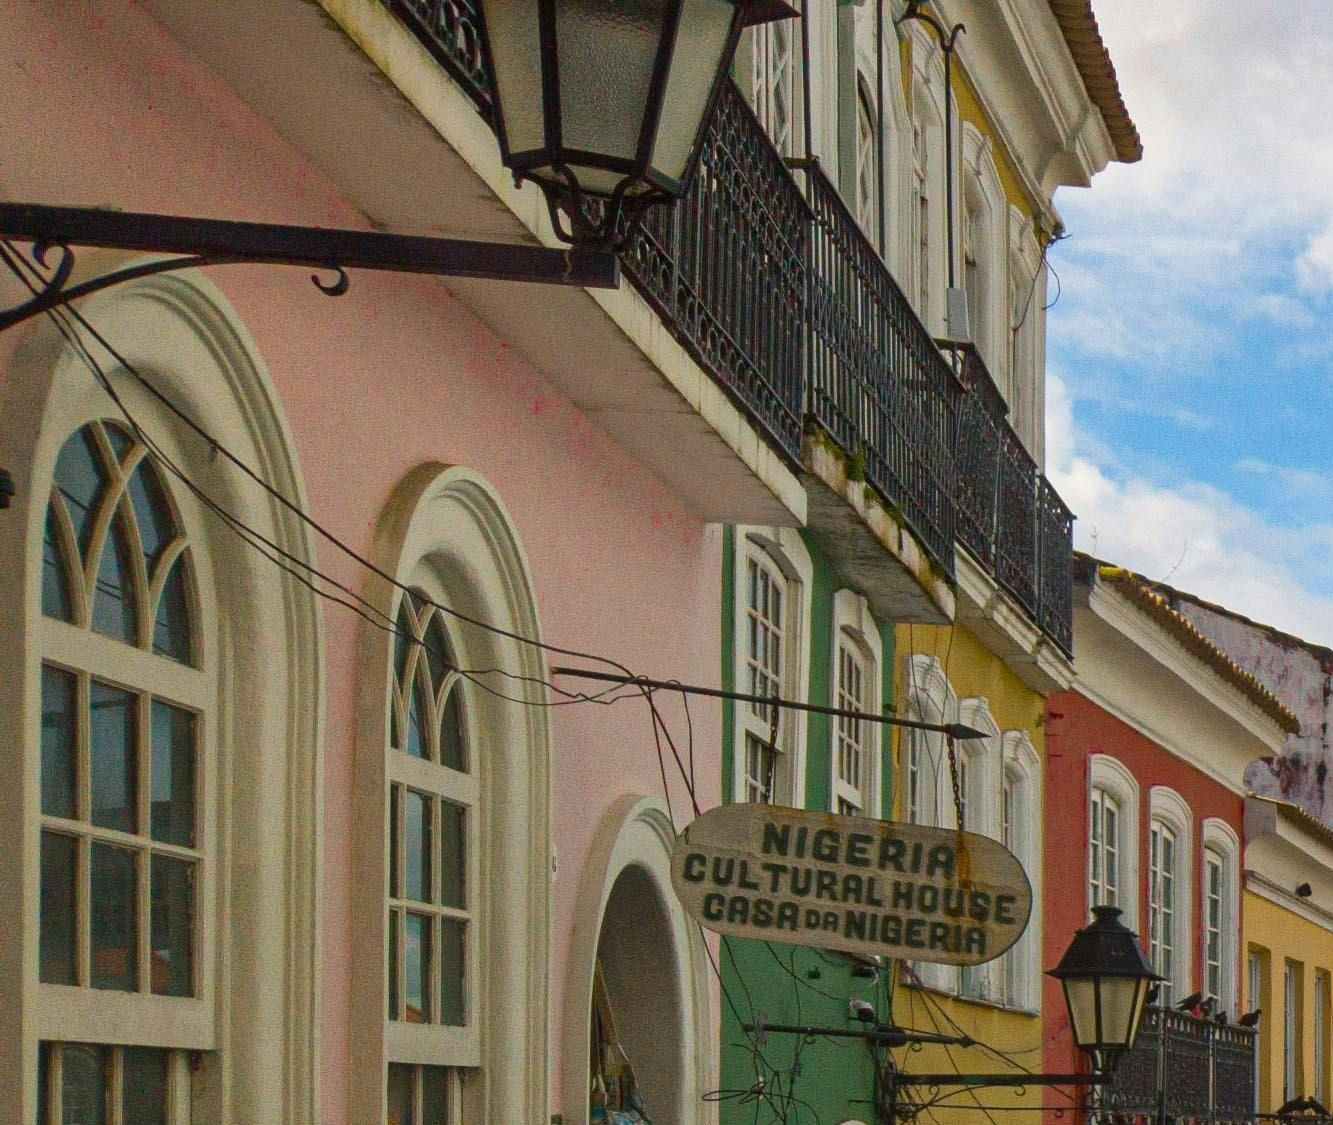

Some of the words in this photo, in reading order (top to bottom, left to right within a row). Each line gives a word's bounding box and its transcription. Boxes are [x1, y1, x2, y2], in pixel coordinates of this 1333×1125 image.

[762, 822, 956, 879] NIGERIA
[683, 853, 890, 908] CULTURAL
[893, 880, 1016, 925] HOUSE
[703, 892, 799, 932] CASA
[805, 908, 838, 932] DA
[843, 910, 986, 955] NIGERIA
